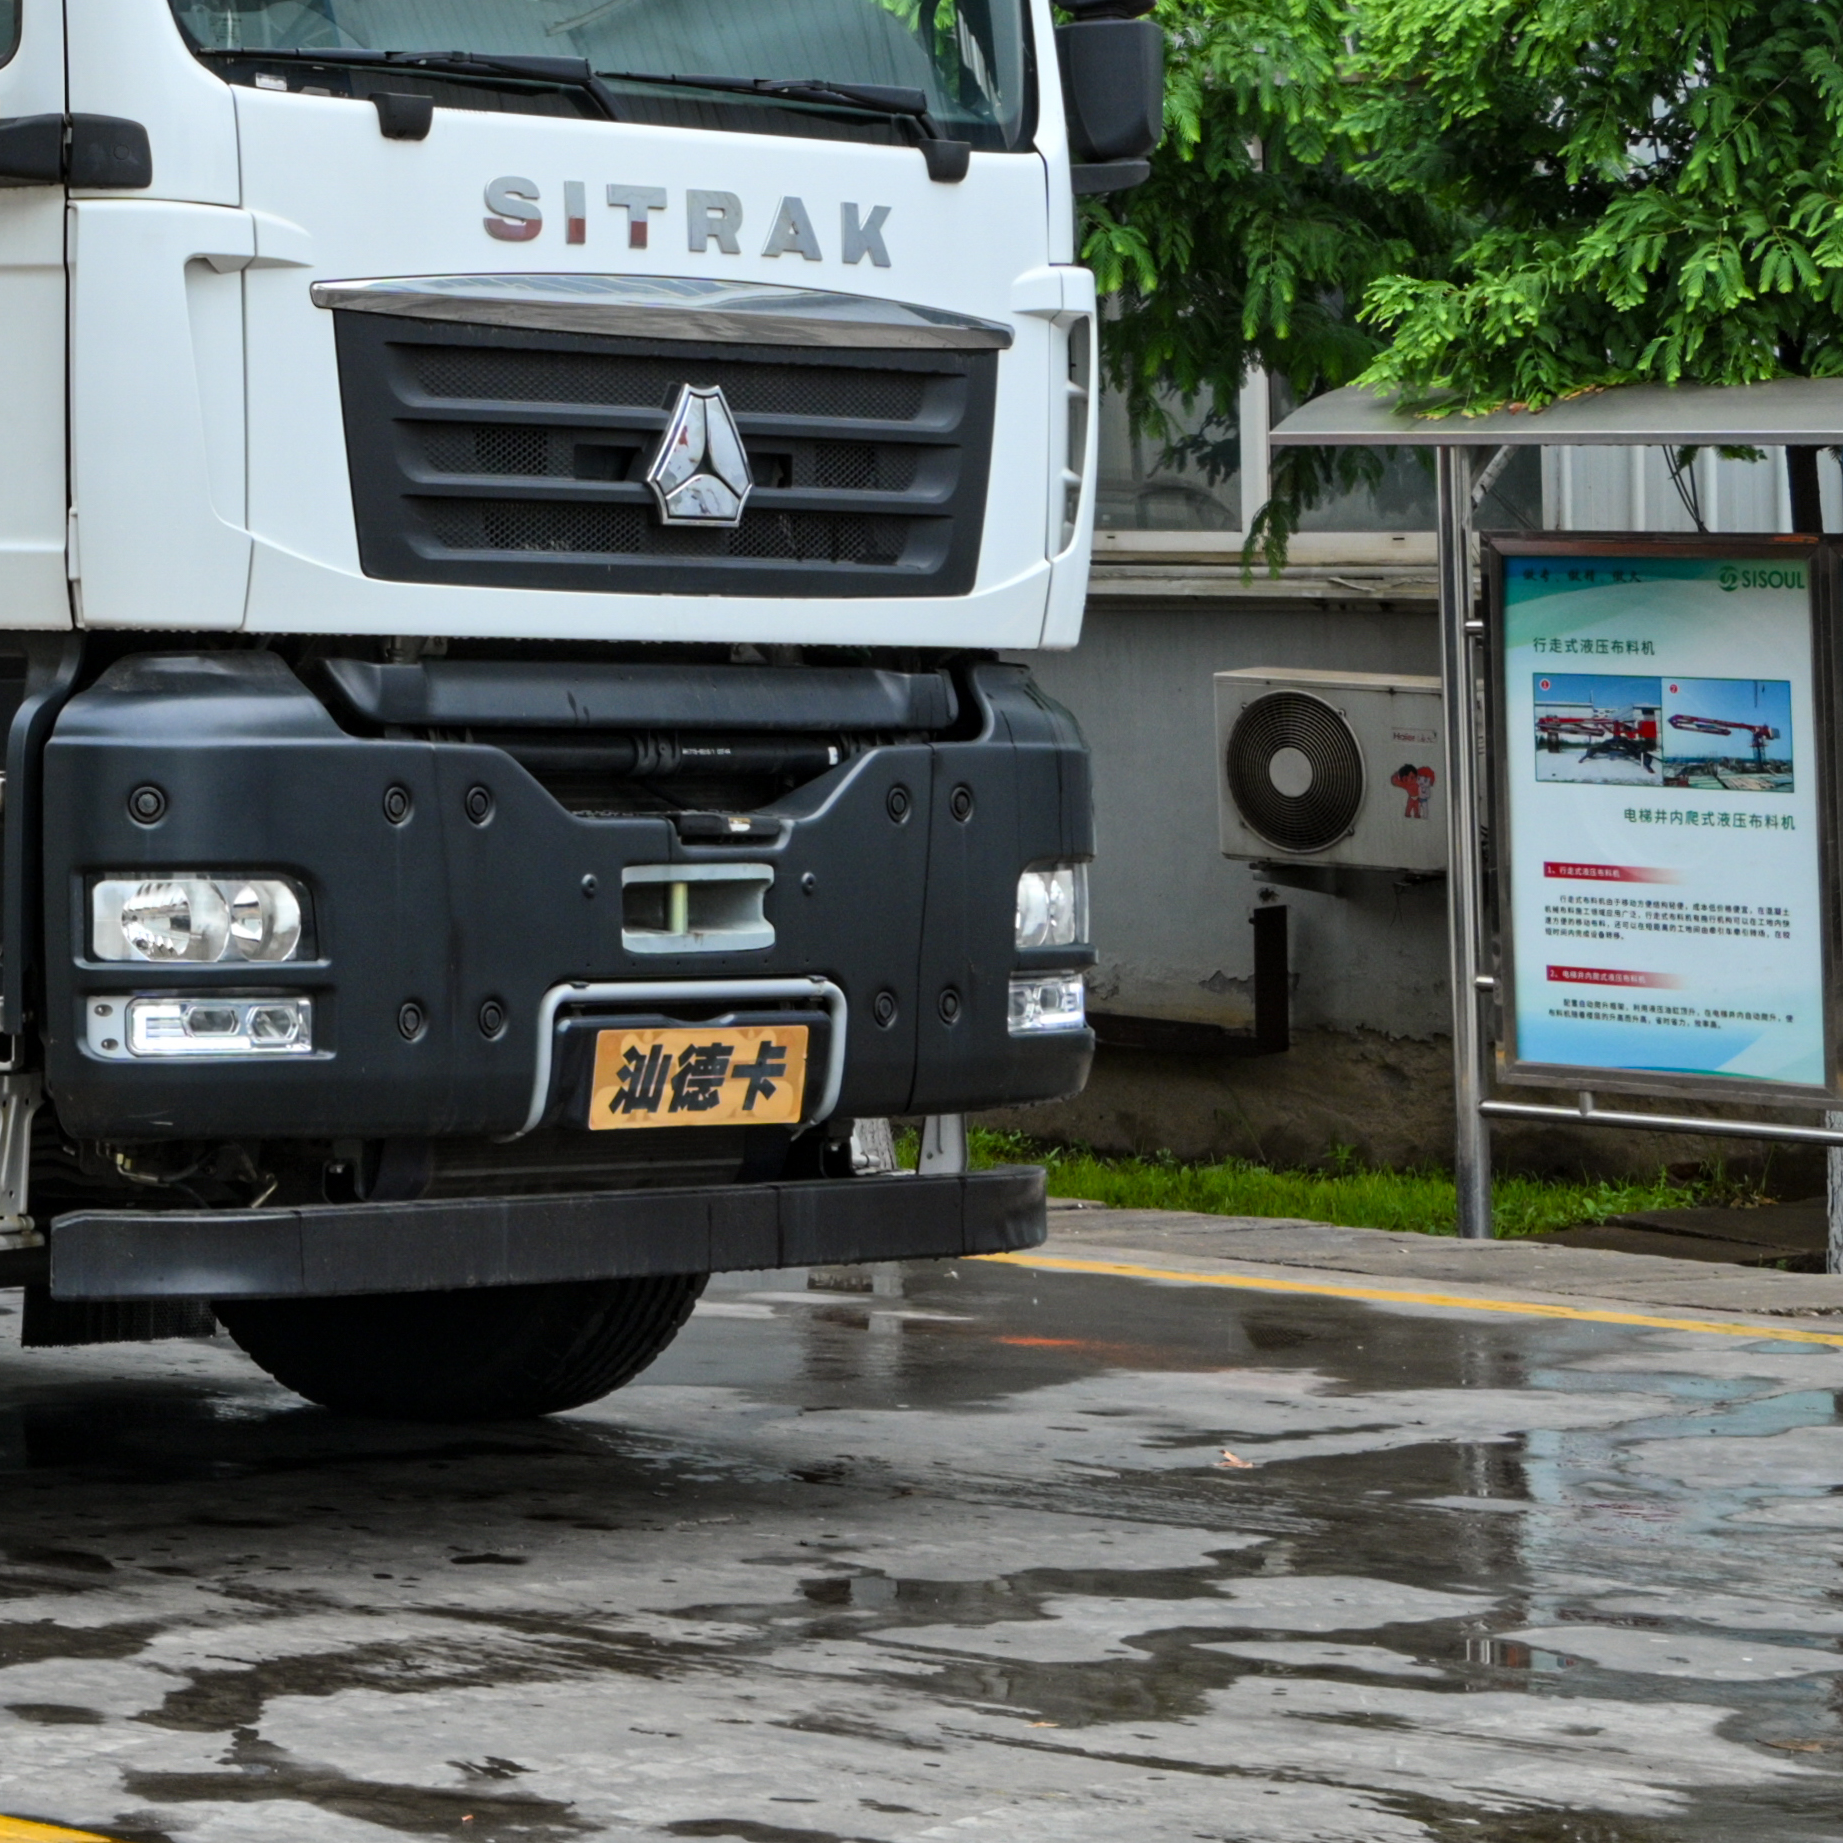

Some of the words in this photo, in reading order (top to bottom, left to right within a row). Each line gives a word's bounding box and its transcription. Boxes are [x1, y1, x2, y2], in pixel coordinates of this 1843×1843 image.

[482, 175, 893, 268] SITRAK
[1741, 569, 1806, 589] SISOUL
[1533, 637, 1656, 656] 行走式液压布料机
[1623, 808, 1796, 830] 电梯井内爬式液压布料机
[609, 1041, 787, 1114] 汕德卡
